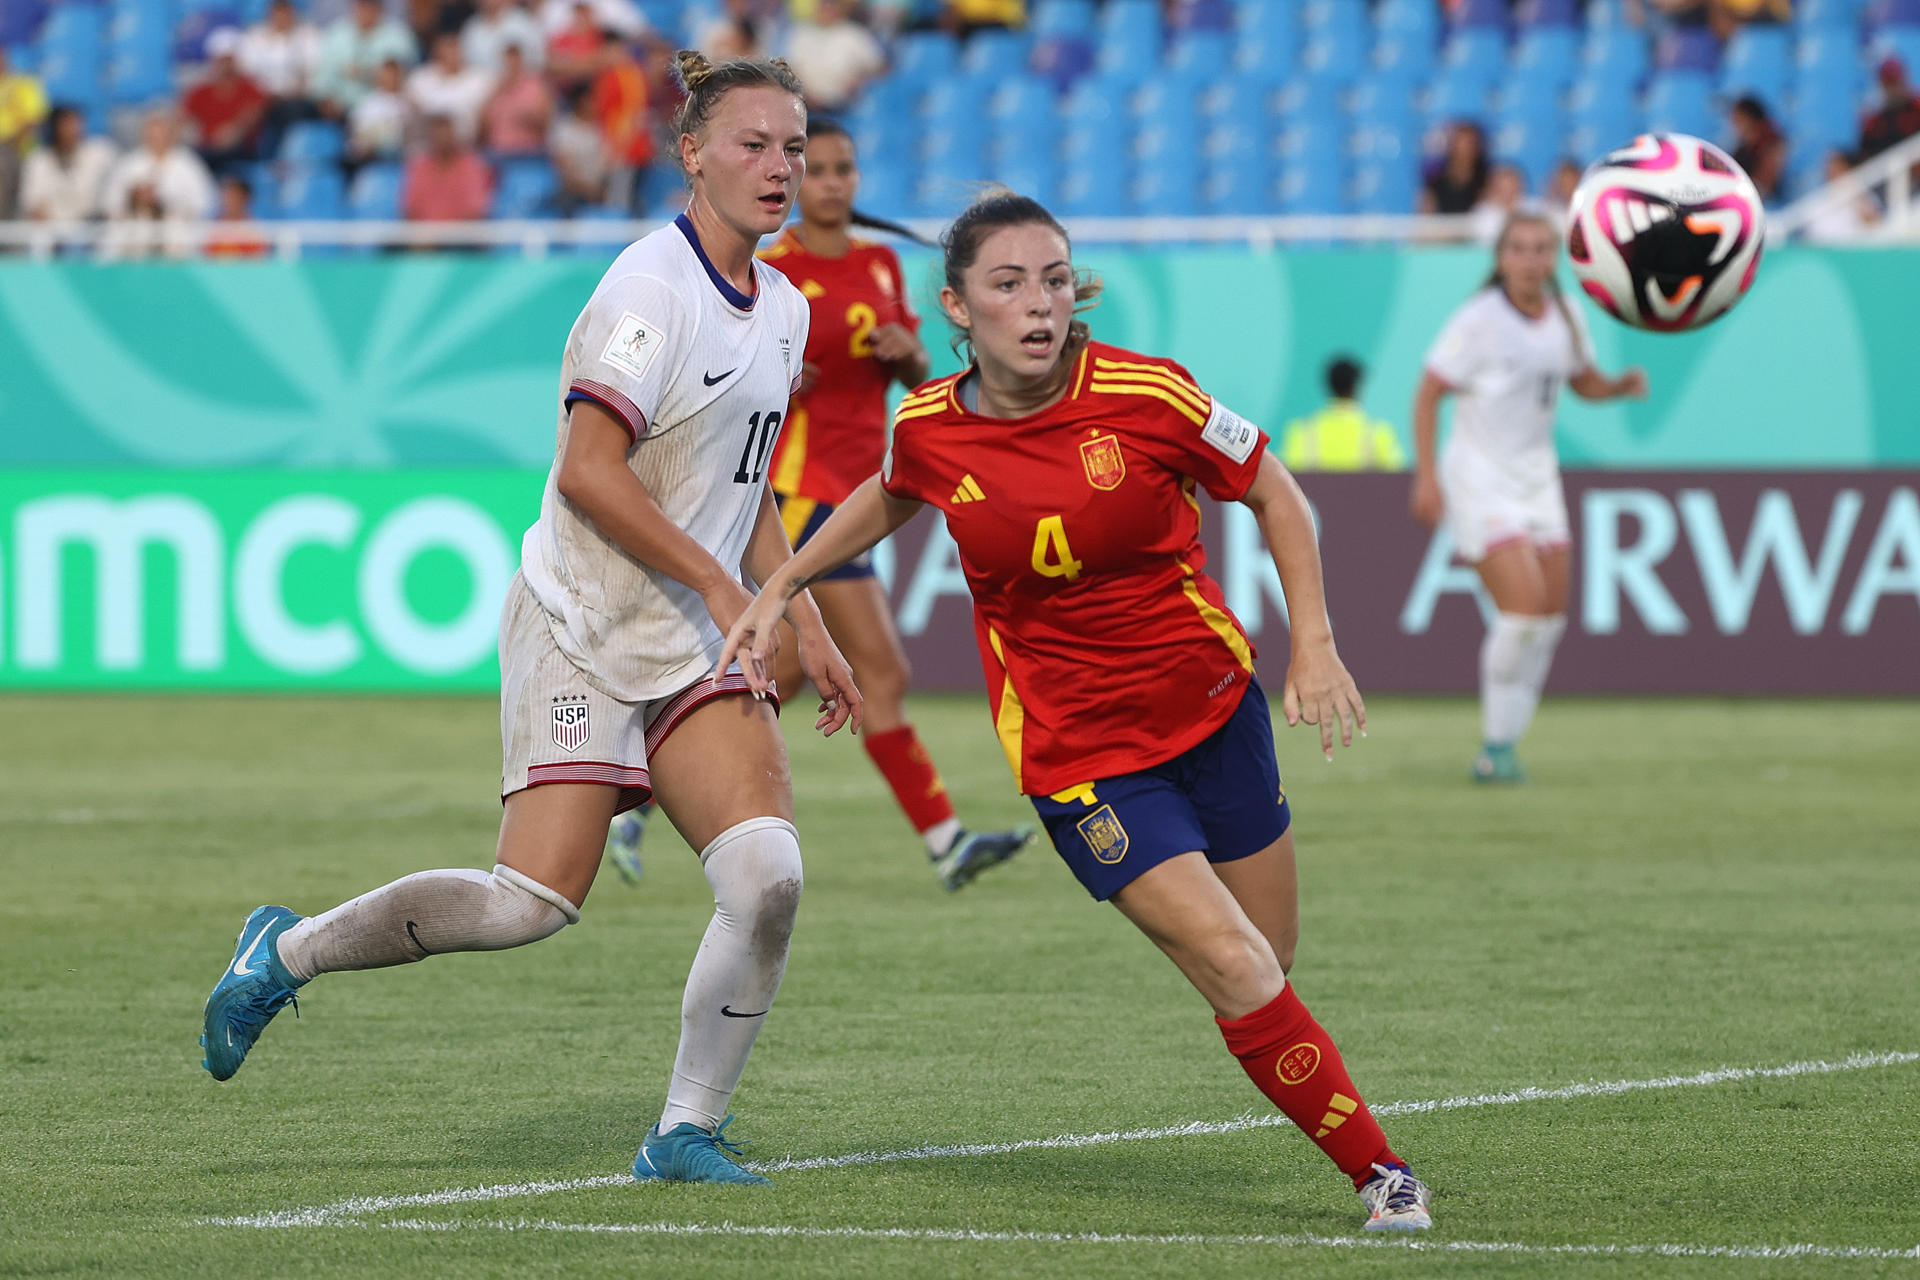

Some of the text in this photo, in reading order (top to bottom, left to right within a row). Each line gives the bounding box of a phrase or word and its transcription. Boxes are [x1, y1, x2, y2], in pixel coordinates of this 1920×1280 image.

[846, 301, 877, 358] 2
[733, 411, 781, 484] 10
[1031, 515, 1082, 581] 4
[555, 707, 586, 725] USA
